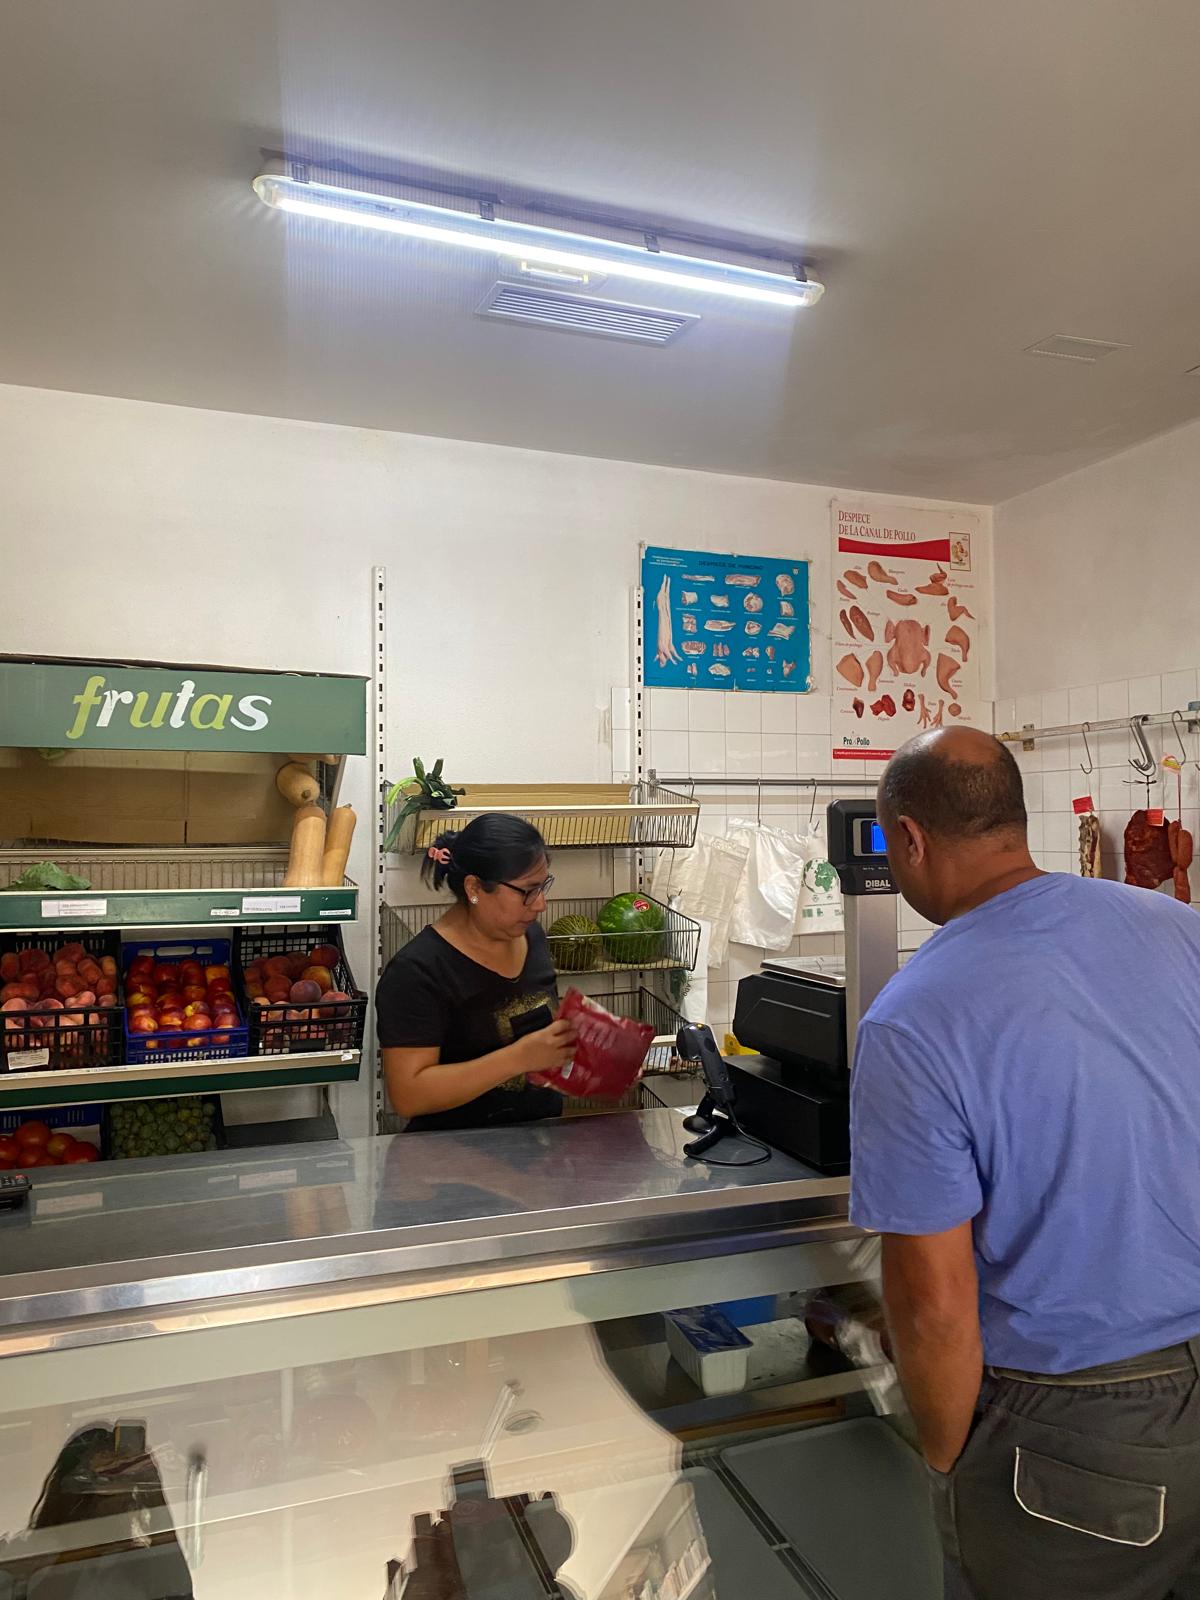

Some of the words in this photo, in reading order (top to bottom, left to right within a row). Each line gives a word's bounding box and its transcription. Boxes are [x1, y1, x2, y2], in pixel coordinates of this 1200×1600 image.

[838, 510, 871, 524] DESPIECE
[838, 523, 849, 535] DE
[849, 525, 859, 536] LA
[859, 526, 882, 538] CANAL
[883, 528, 894, 540] DE
[894, 529, 916, 541] POLLO
[65, 675, 272, 740] frutas
[856, 737, 871, 746] Pollo
[865, 879, 891, 888] DIBAL
